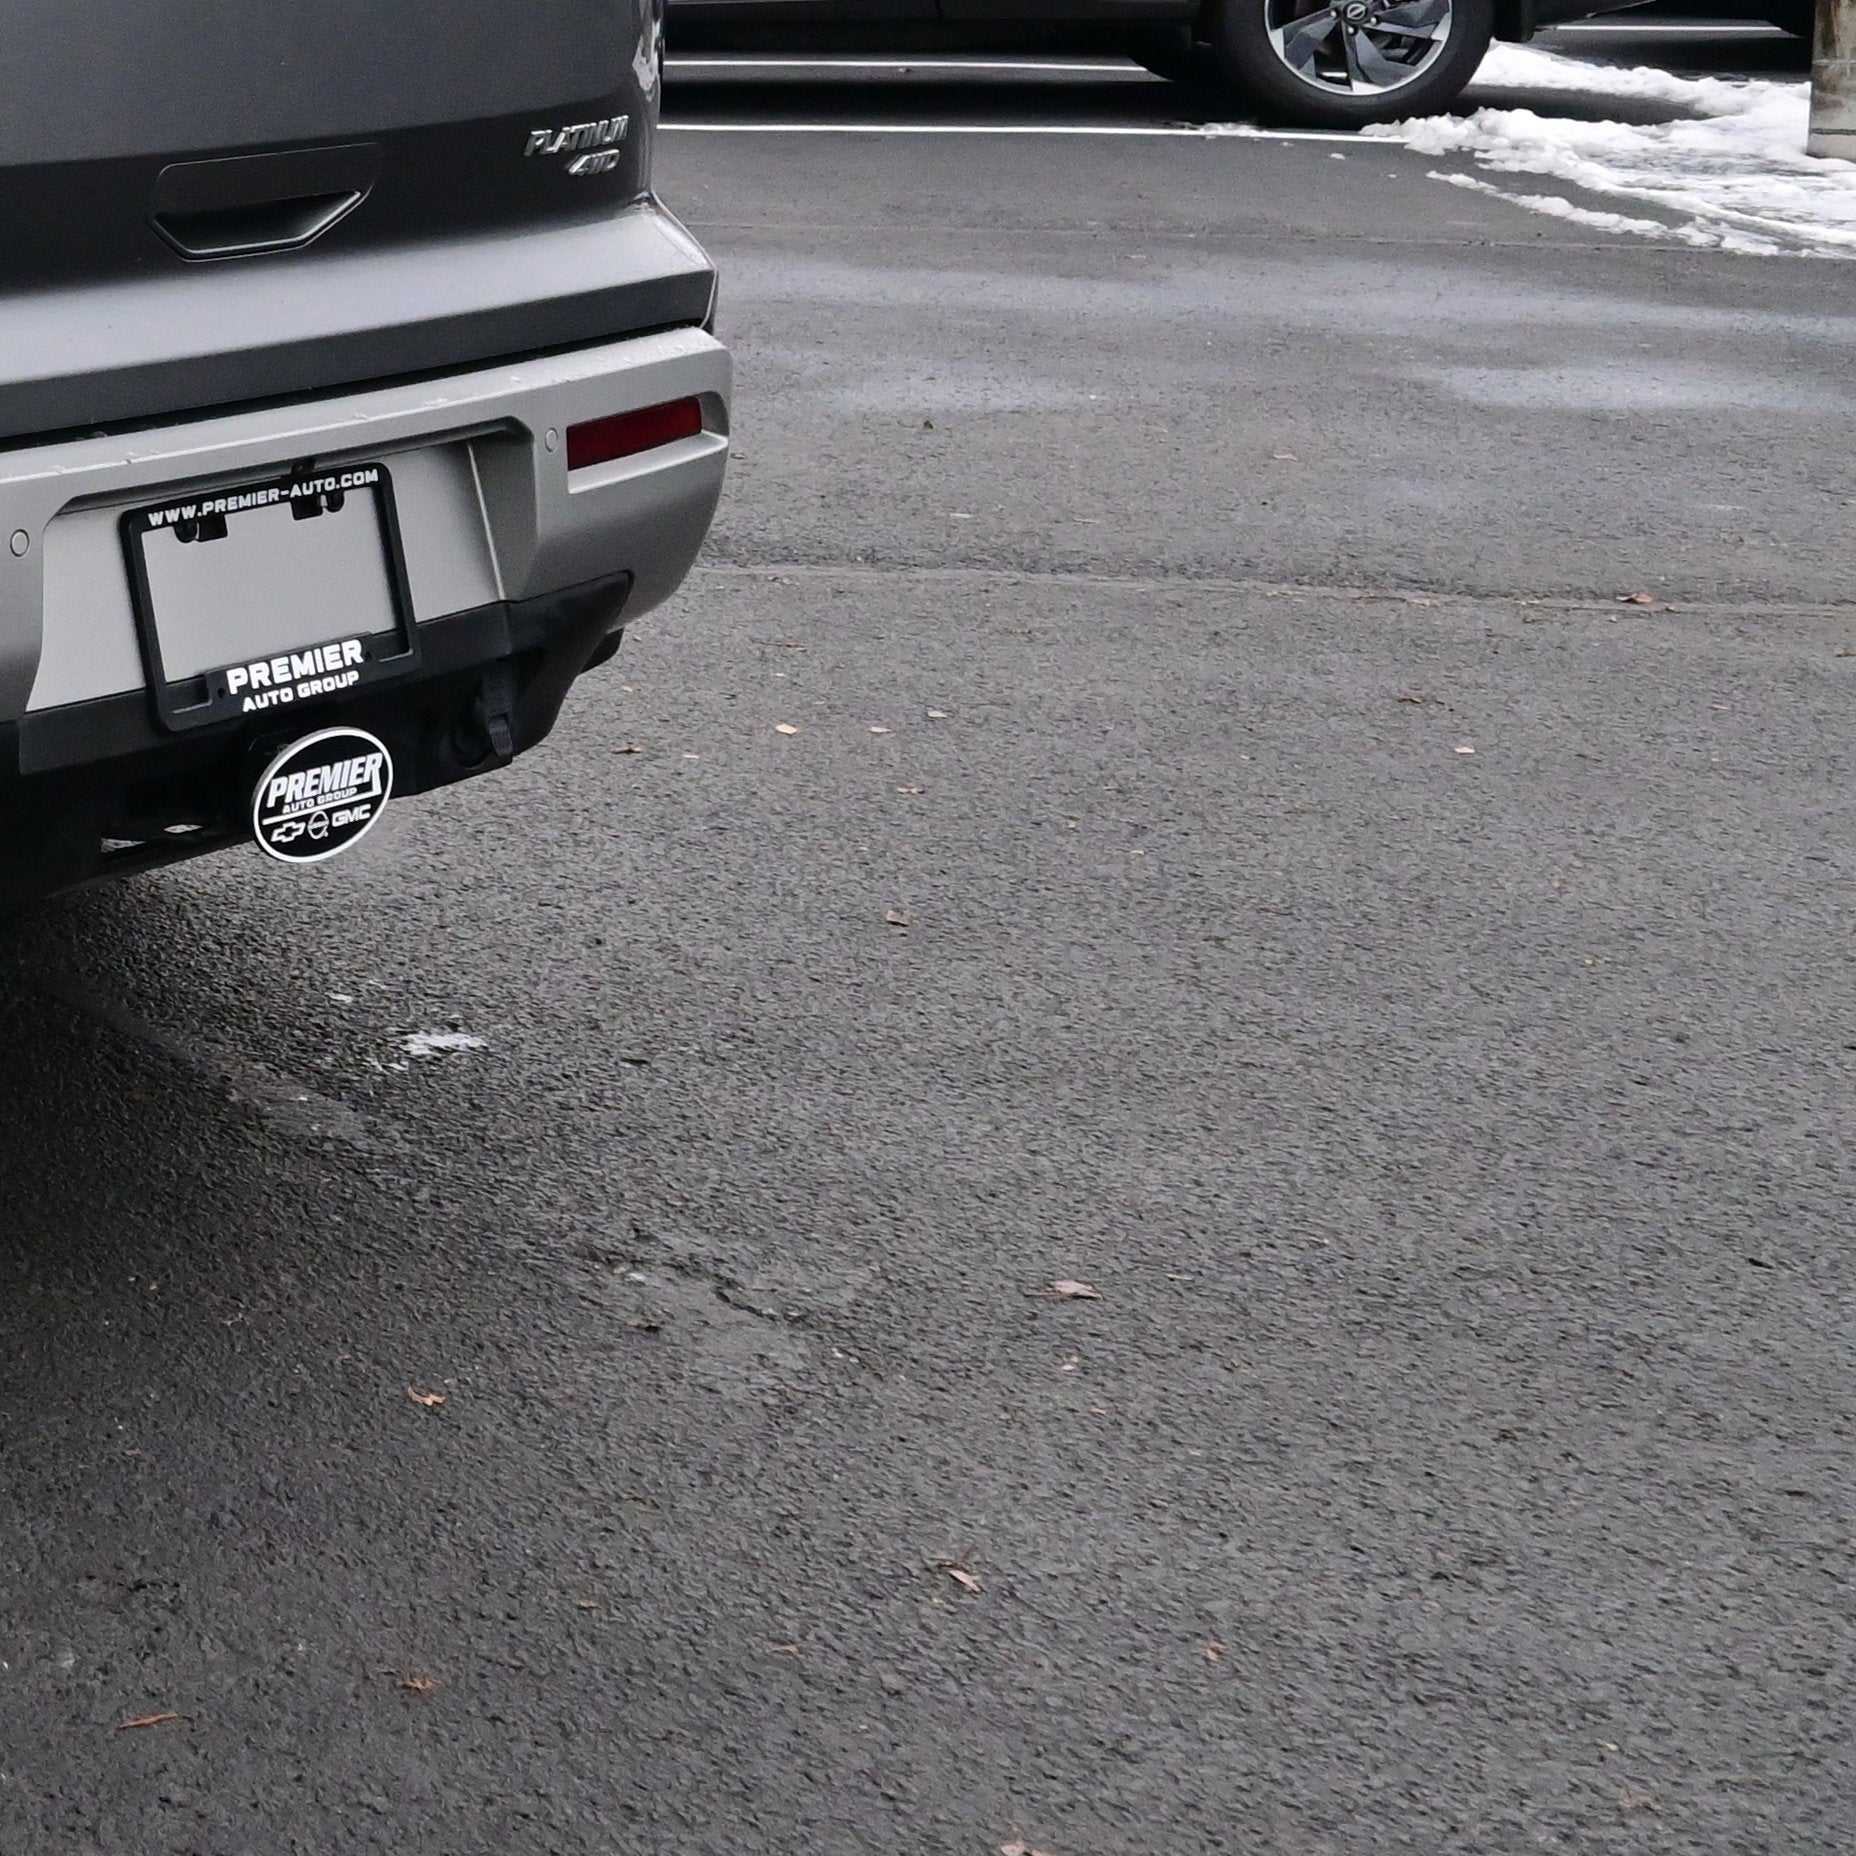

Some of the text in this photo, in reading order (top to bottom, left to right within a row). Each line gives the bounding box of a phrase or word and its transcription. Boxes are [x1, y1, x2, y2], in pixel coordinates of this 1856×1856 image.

[523, 114, 629, 157] PLATINUM
[147, 468, 379, 527] WWW.PREMIER-AUTO.COM
[226, 639, 364, 695] PREMIER
[242, 670, 360, 713] AUTO GROUP
[266, 752, 383, 808] PREMIER
[282, 787, 358, 814] AUTO GROUP
[331, 803, 371, 827] GMC
